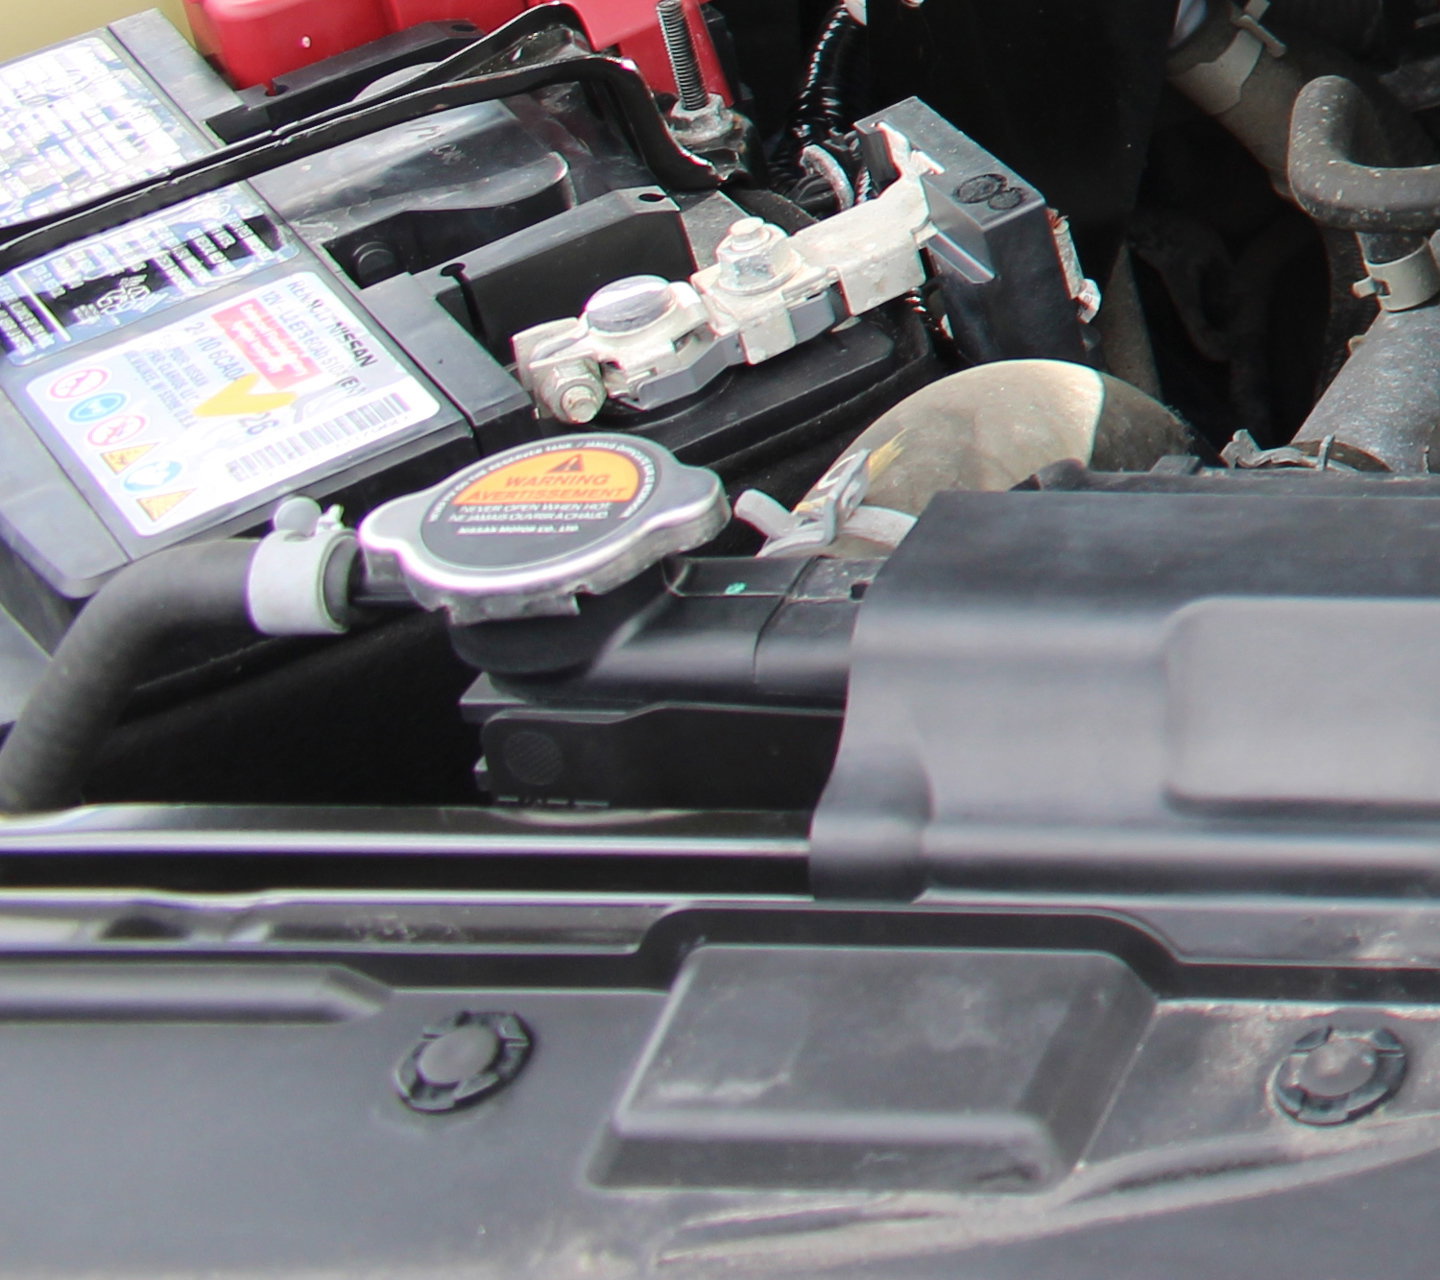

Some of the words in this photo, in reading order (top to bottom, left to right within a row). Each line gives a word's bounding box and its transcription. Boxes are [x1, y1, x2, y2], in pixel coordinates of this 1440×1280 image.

[322, 320, 380, 368] NISSAN
[505, 474, 611, 487] WARNING
[465, 488, 627, 502] AVERTISSEMENT
[459, 504, 502, 513] NEVER
[504, 504, 539, 512] OPEN
[542, 503, 581, 511] WHEN
[457, 526, 499, 535] NISSAN
[500, 525, 536, 534] MOTOR
